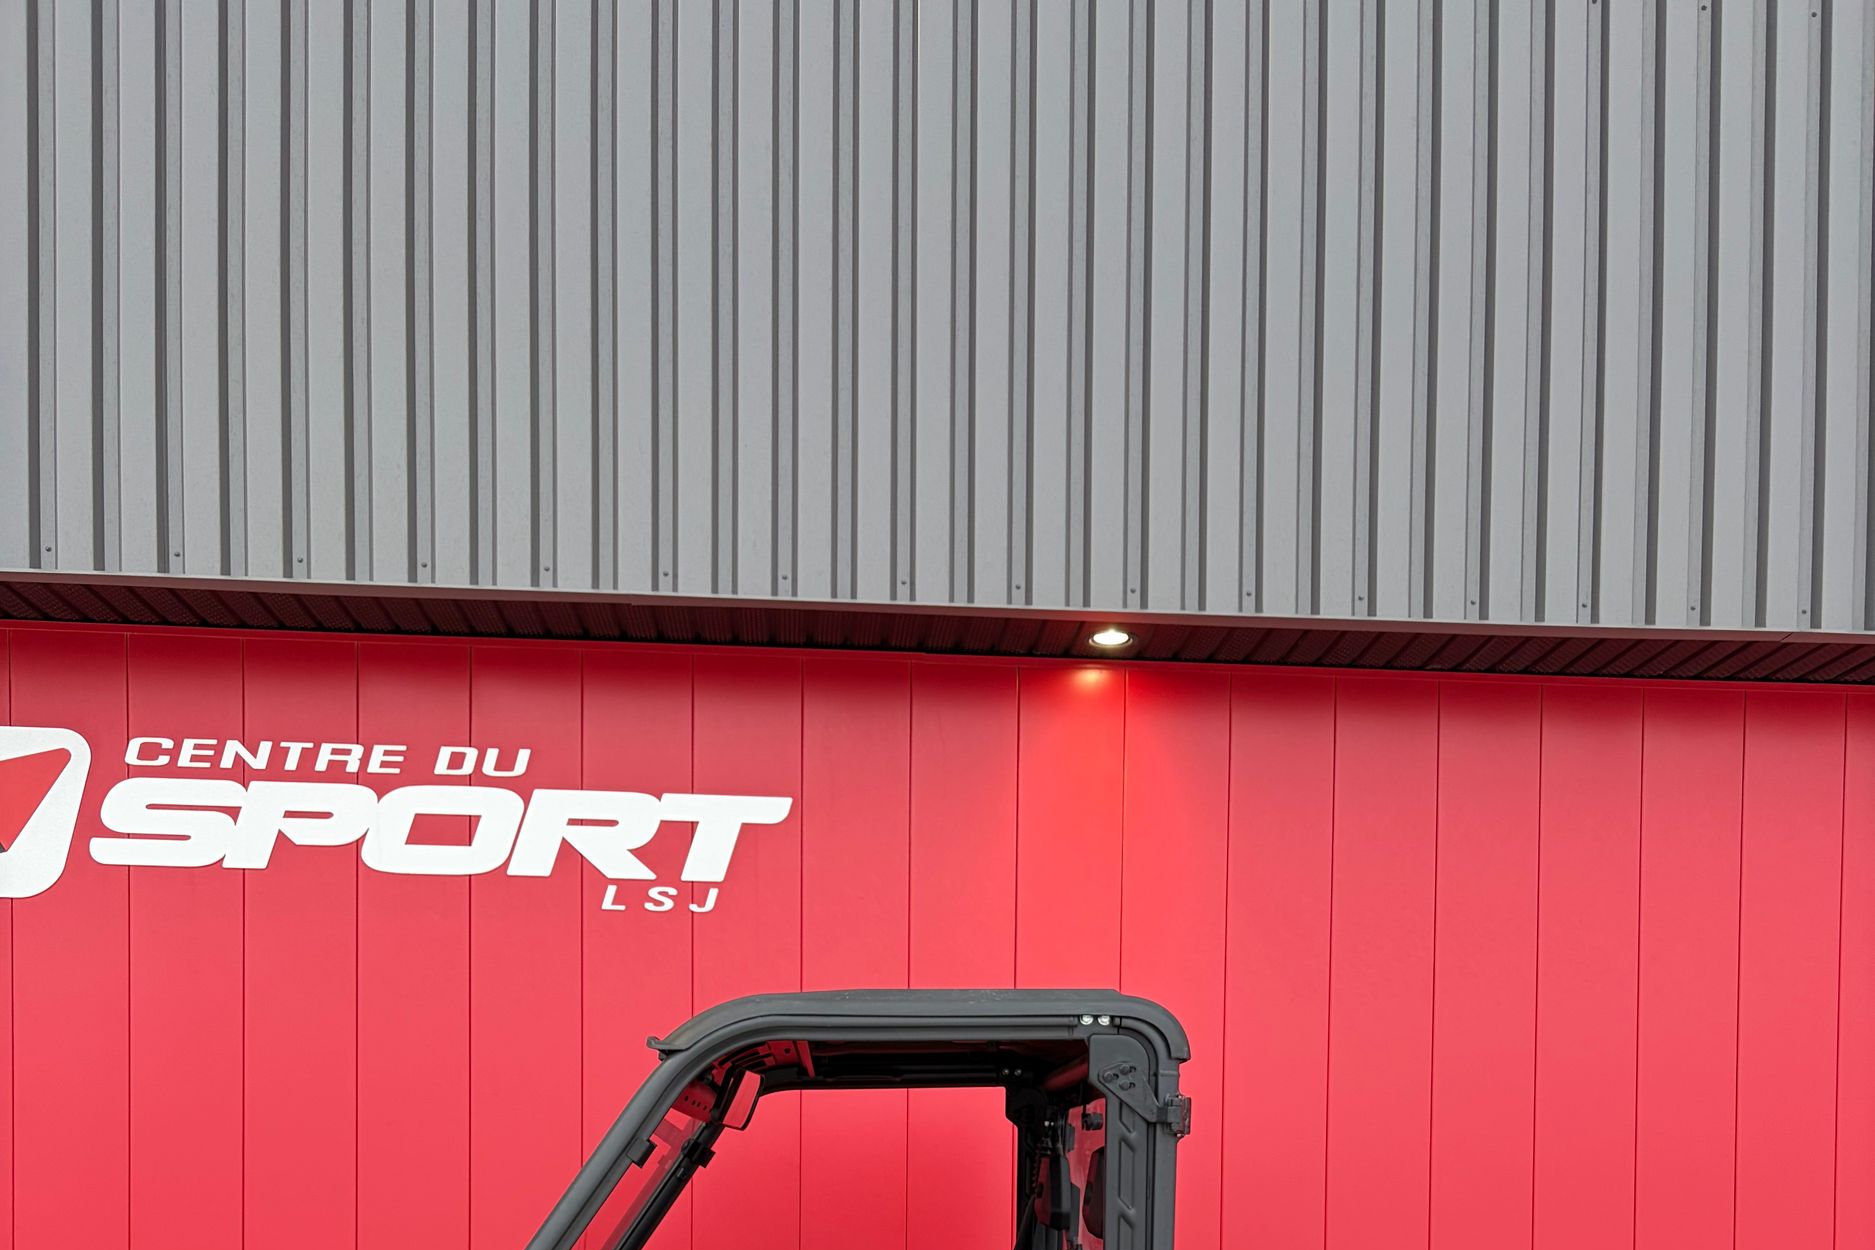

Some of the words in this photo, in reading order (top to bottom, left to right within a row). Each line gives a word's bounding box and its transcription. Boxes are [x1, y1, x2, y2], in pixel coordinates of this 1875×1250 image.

[124, 736, 407, 774] CENTRE
[433, 746, 532, 777] DU
[89, 777, 793, 883] SPORT
